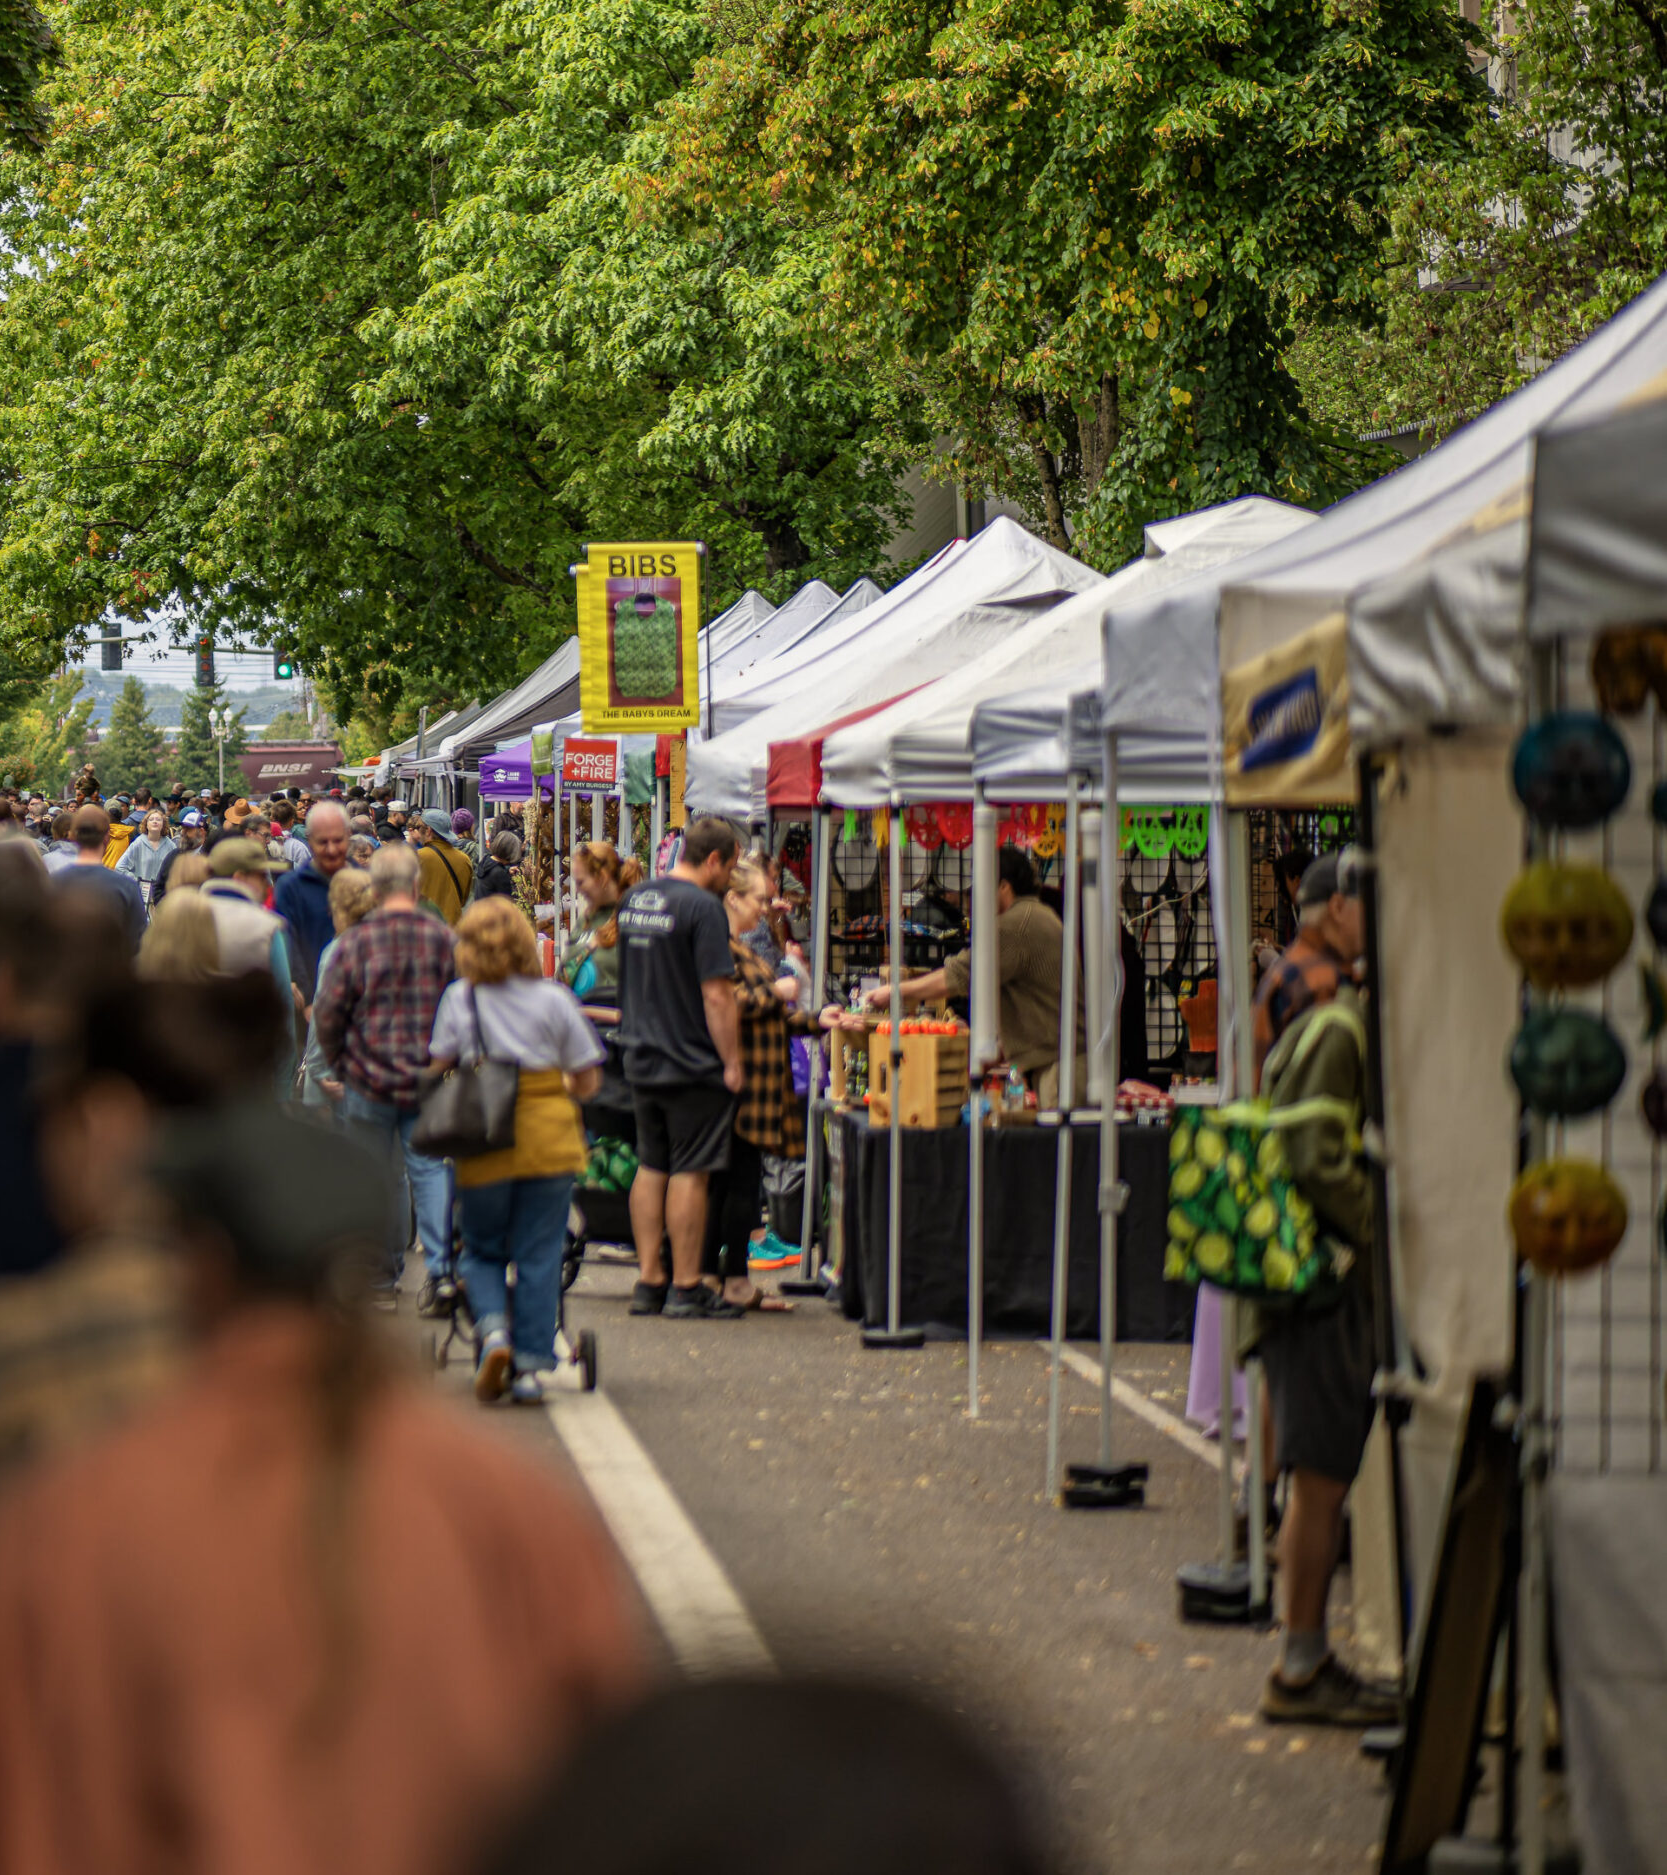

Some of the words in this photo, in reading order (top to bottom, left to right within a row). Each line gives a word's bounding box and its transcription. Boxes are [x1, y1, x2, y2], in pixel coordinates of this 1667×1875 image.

[608, 555, 676, 577] BIBS
[602, 710, 620, 718] THE
[622, 710, 654, 718] BABYS
[656, 709, 691, 718] DREAM
[565, 753, 614, 767] FORGE
[260, 763, 313, 773] BNSF
[571, 766, 613, 779] +FIRE
